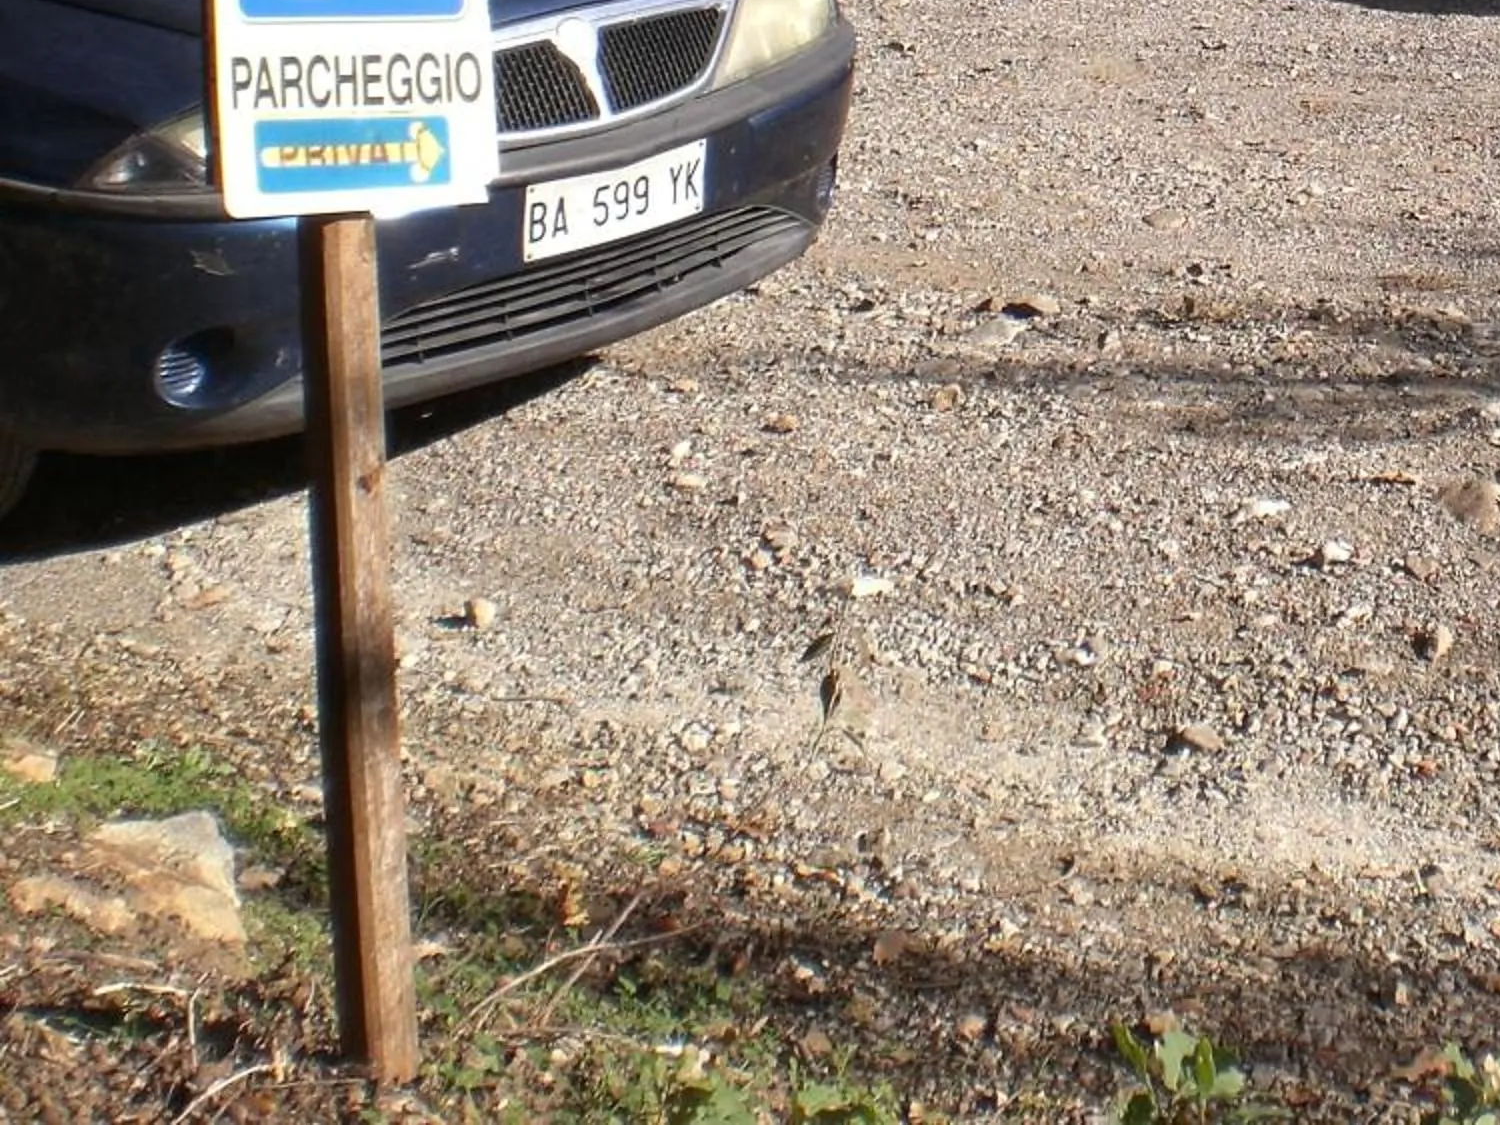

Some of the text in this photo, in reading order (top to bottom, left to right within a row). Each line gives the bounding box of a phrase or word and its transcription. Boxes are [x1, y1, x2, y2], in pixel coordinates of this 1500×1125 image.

[231, 52, 482, 109] PARCHEGGIO
[528, 157, 701, 243] BA 599 YK
